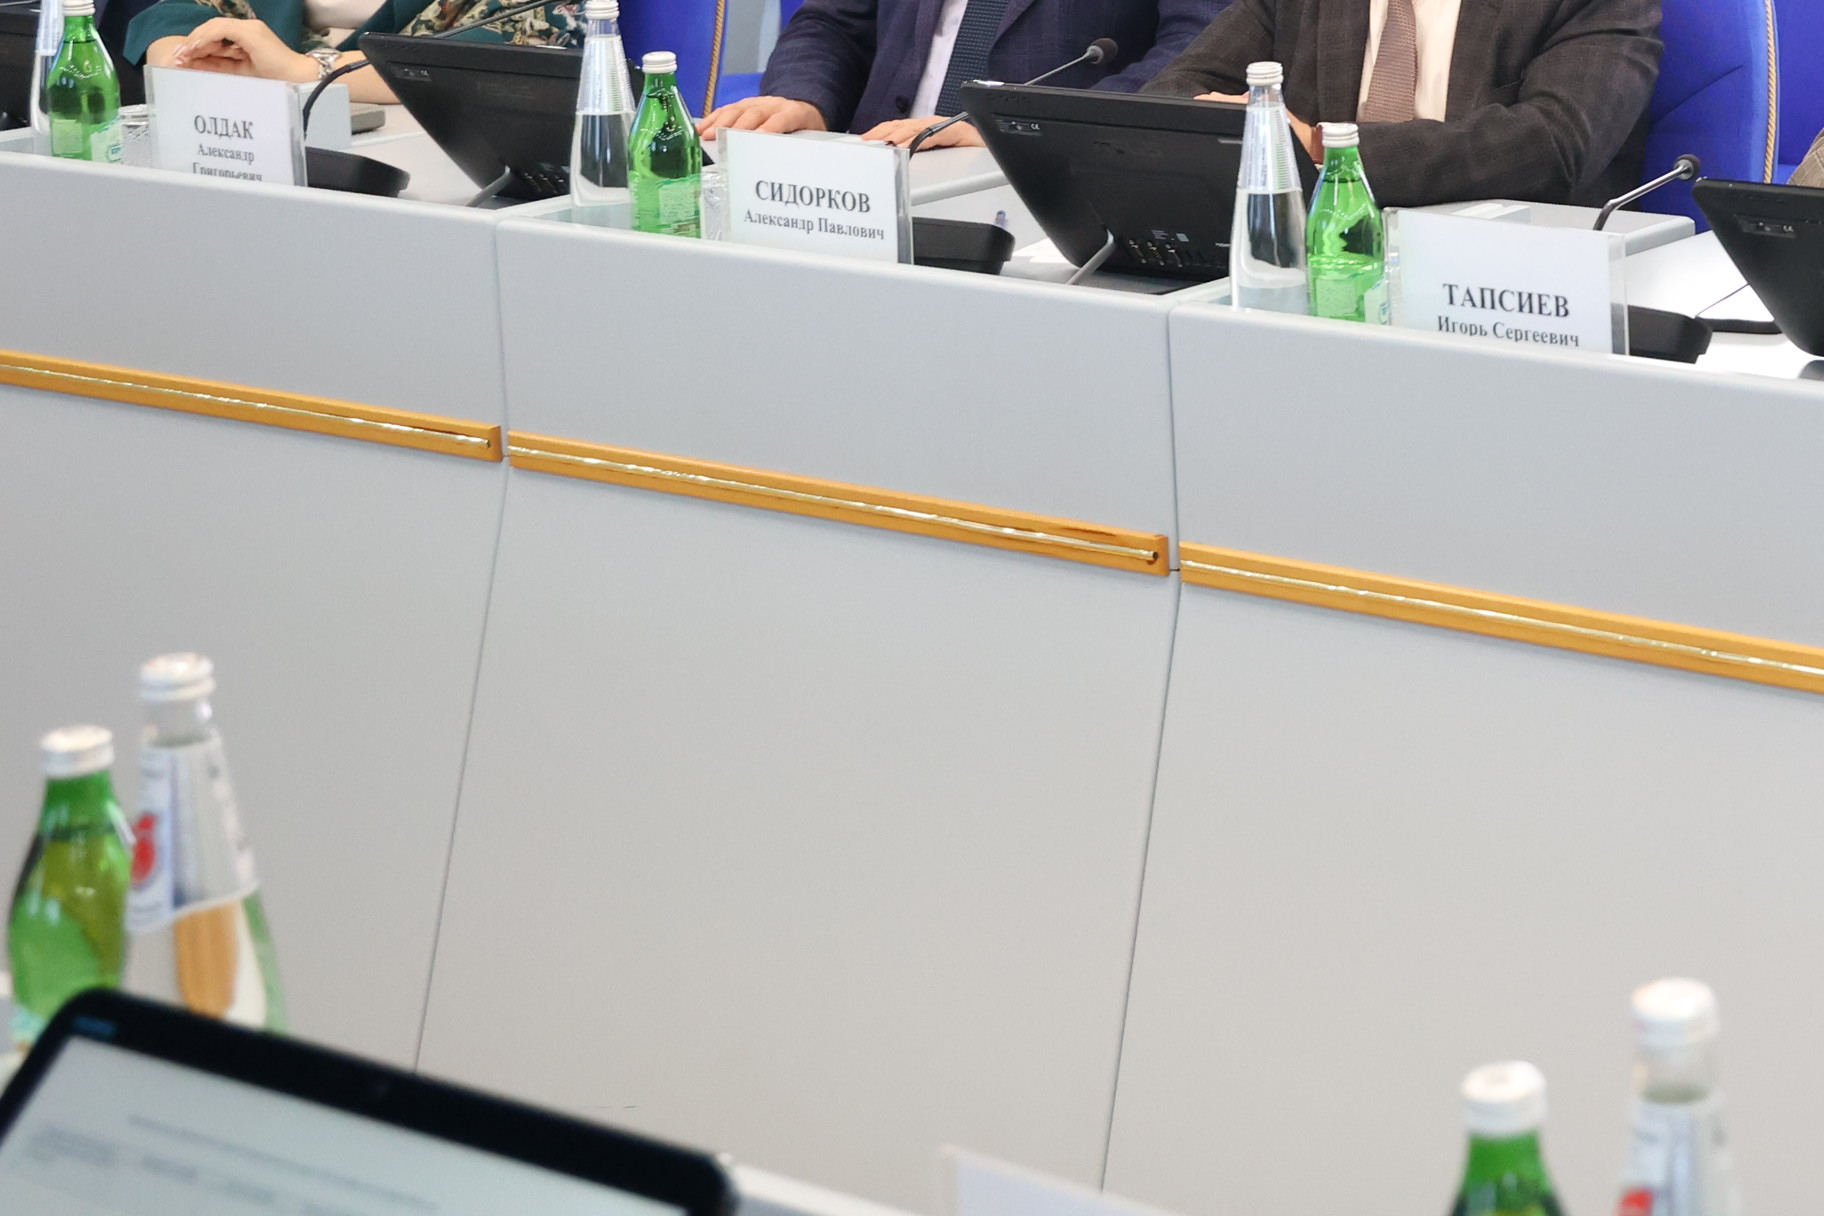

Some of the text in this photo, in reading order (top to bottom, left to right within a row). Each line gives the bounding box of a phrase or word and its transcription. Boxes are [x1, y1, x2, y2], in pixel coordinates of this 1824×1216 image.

[194, 115, 254, 140] ОЛДАК
[197, 144, 255, 165] Александр
[755, 180, 871, 213] СИДОРКОВ
[743, 209, 885, 240] Александр Павлович
[1442, 283, 1570, 318] ТАПСИЕВ
[1437, 315, 1580, 347] Игорь Сергеевич
